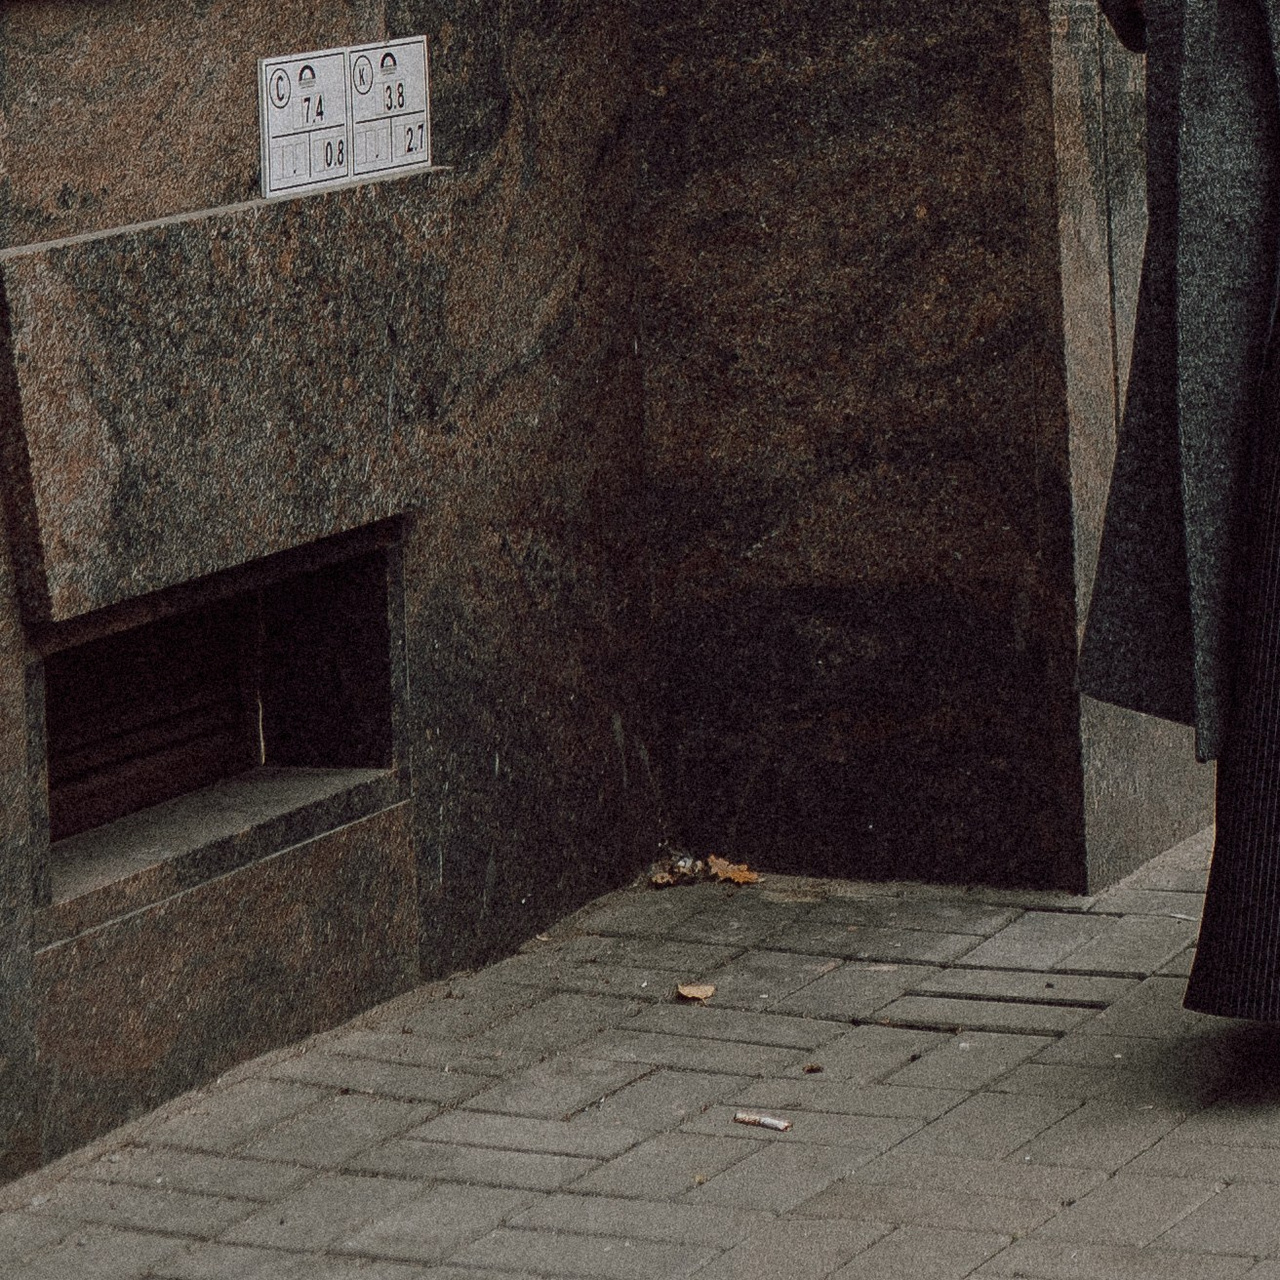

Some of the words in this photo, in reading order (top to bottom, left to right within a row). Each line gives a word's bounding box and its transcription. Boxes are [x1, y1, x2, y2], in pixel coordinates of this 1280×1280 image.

[303, 95, 324, 123] 7.4
[385, 83, 405, 111] 3.8
[406, 124, 424, 153] 2.7
[325, 139, 344, 168] 0.8
